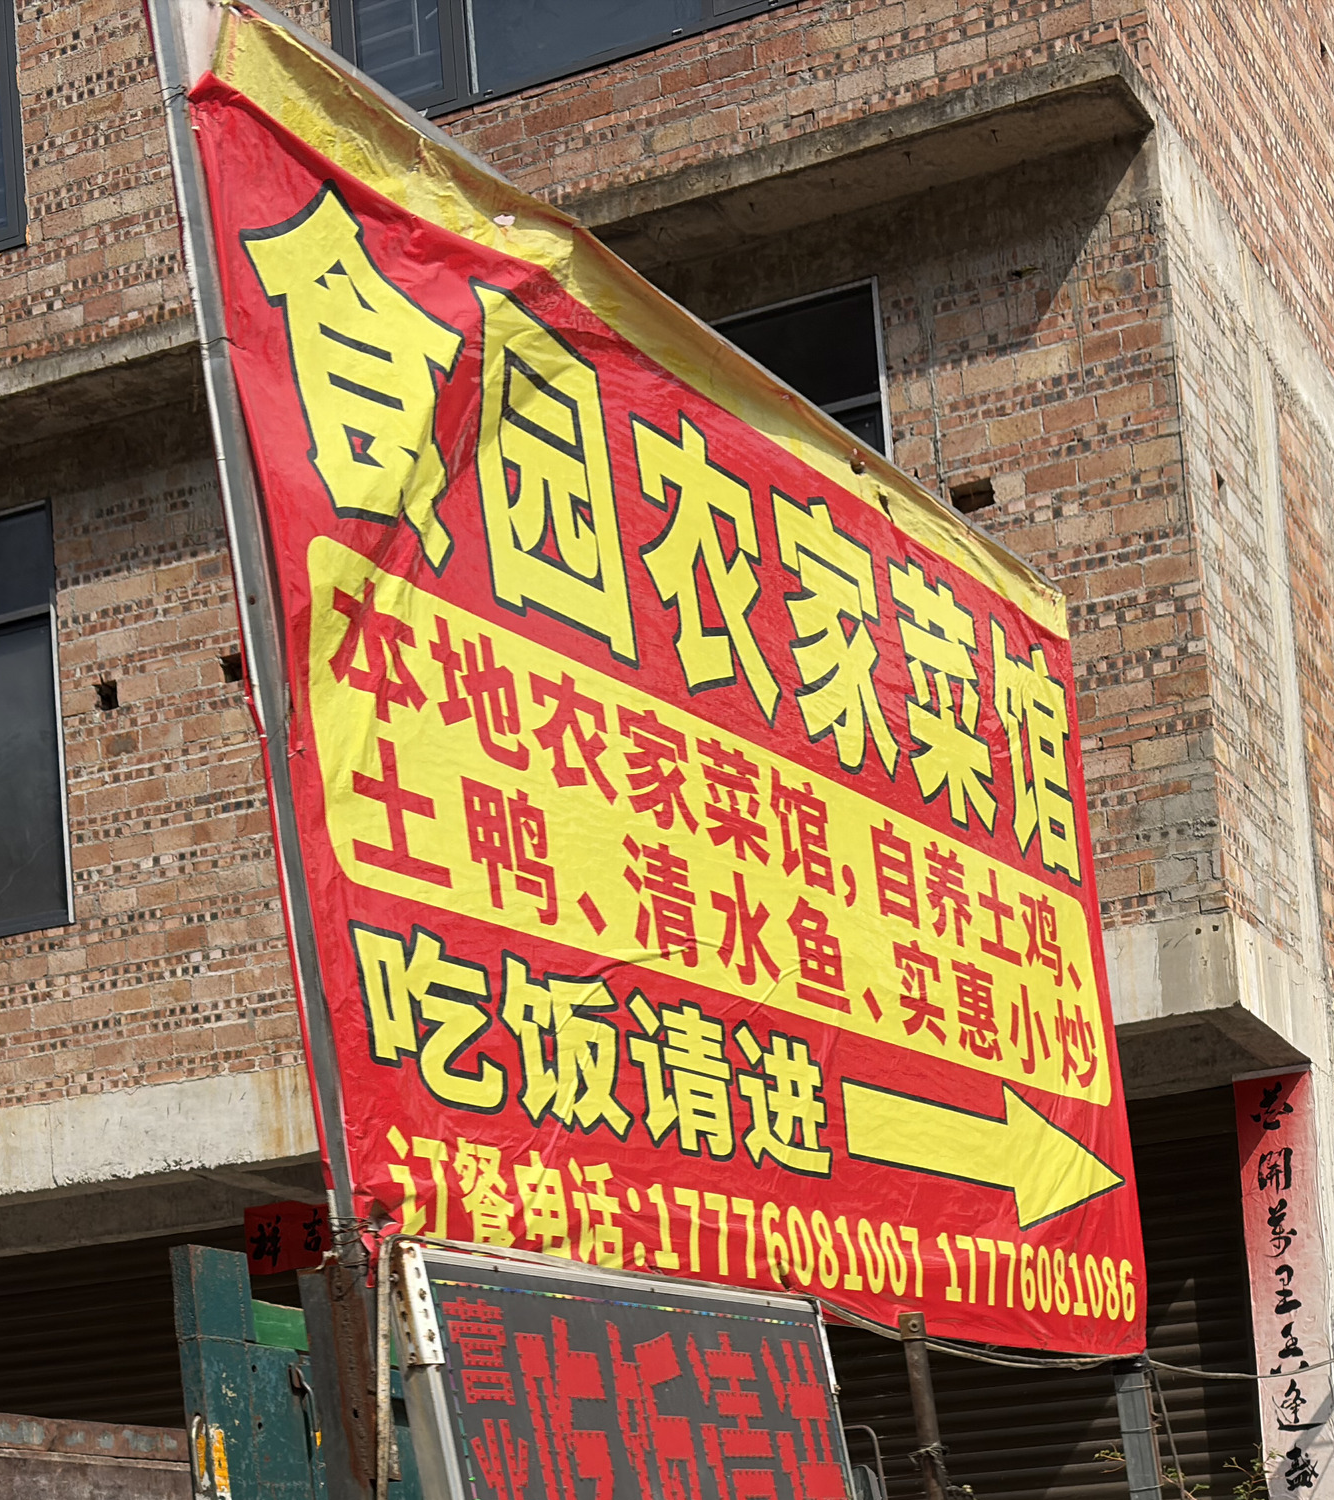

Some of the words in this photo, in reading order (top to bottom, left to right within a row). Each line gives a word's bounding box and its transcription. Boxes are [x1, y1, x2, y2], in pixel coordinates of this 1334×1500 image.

[348, 919, 833, 1178] 吃饭请进
[942, 1234, 1137, 1323] 17776081086
